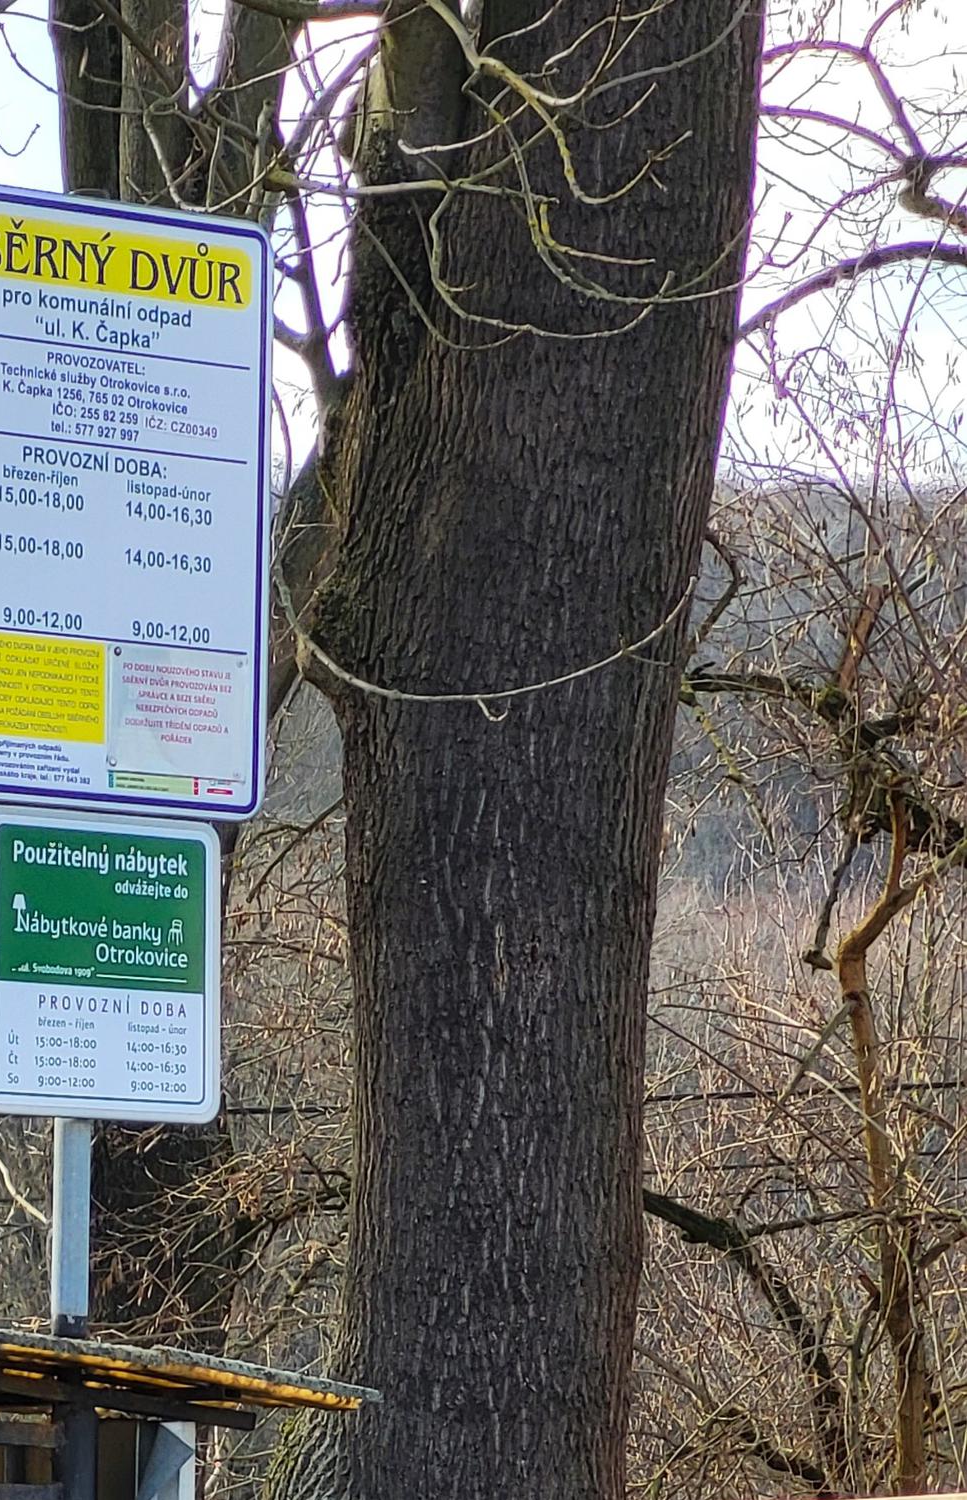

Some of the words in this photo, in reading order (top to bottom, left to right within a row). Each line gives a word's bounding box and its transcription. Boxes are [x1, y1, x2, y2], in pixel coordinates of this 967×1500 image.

[129, 243, 243, 304] DVŮR
[3, 289, 32, 307] pro
[38, 290, 131, 319] komunální
[138, 305, 191, 329] odpad
[73, 325, 89, 341] K.
[47, 352, 145, 375] PROVOZOVATEL:
[0, 362, 56, 381] Technické
[60, 371, 96, 387] služby
[100, 376, 159, 394] Otrokovice
[164, 387, 190, 399] s.r.o.
[3, 381, 14, 392] K.
[18, 382, 52, 397] Čapka
[58, 388, 85, 402] 1256,
[89, 392, 108, 404] 765
[112, 393, 124, 405] 02
[128, 396, 187, 414] Otrokovice
[51, 421, 71, 433] tel.:
[75, 423, 93, 436] 577
[98, 426, 116, 439] 927
[121, 429, 139, 441] 997
[53, 402, 76, 417] IČO:
[81, 407, 99, 420] 255
[103, 410, 115, 422] 82
[120, 412, 138, 424] 259
[145, 416, 166, 431] IČZ:
[171, 422, 217, 438] CZ00349
[23, 446, 109, 473] PROVOZNÍ
[115, 458, 167, 479] DOBA:
[3, 465, 78, 487] březen-říjen
[127, 480, 211, 502] listopad-únor
[126, 501, 212, 527] 14,00-16,30
[125, 549, 211, 574] 14,00-16,30
[3, 607, 82, 631] 9,00-12,00
[132, 621, 210, 644] 9,00-12,00
[13, 840, 109, 874] Použitelný
[115, 846, 188, 878] nábytek
[115, 878, 171, 899] odvážejte
[174, 885, 188, 899] do
[15, 909, 107, 938] Nábytkové
[112, 921, 161, 945] banky
[96, 943, 188, 968] Otrokovice
[38, 994, 130, 1014] PROVOZNÍ
[141, 1001, 187, 1017] DOBA
[38, 1018, 66, 1028] březen
[75, 1018, 94, 1031] říjen
[128, 1022, 159, 1035] listopad
[169, 1024, 187, 1035] únor
[8, 1030, 19, 1045] Út
[35, 1036, 97, 1049] 15:00-18:00
[127, 1042, 187, 1055] 14:00-16:30
[8, 1051, 18, 1065] Čt
[34, 1056, 96, 1069] 15:00-18:00
[126, 1061, 186, 1075] 14:00-16:30
[8, 1073, 19, 1084] So
[38, 1075, 95, 1088] 9:00-12:00
[131, 1081, 187, 1093] 9:00-12:00
